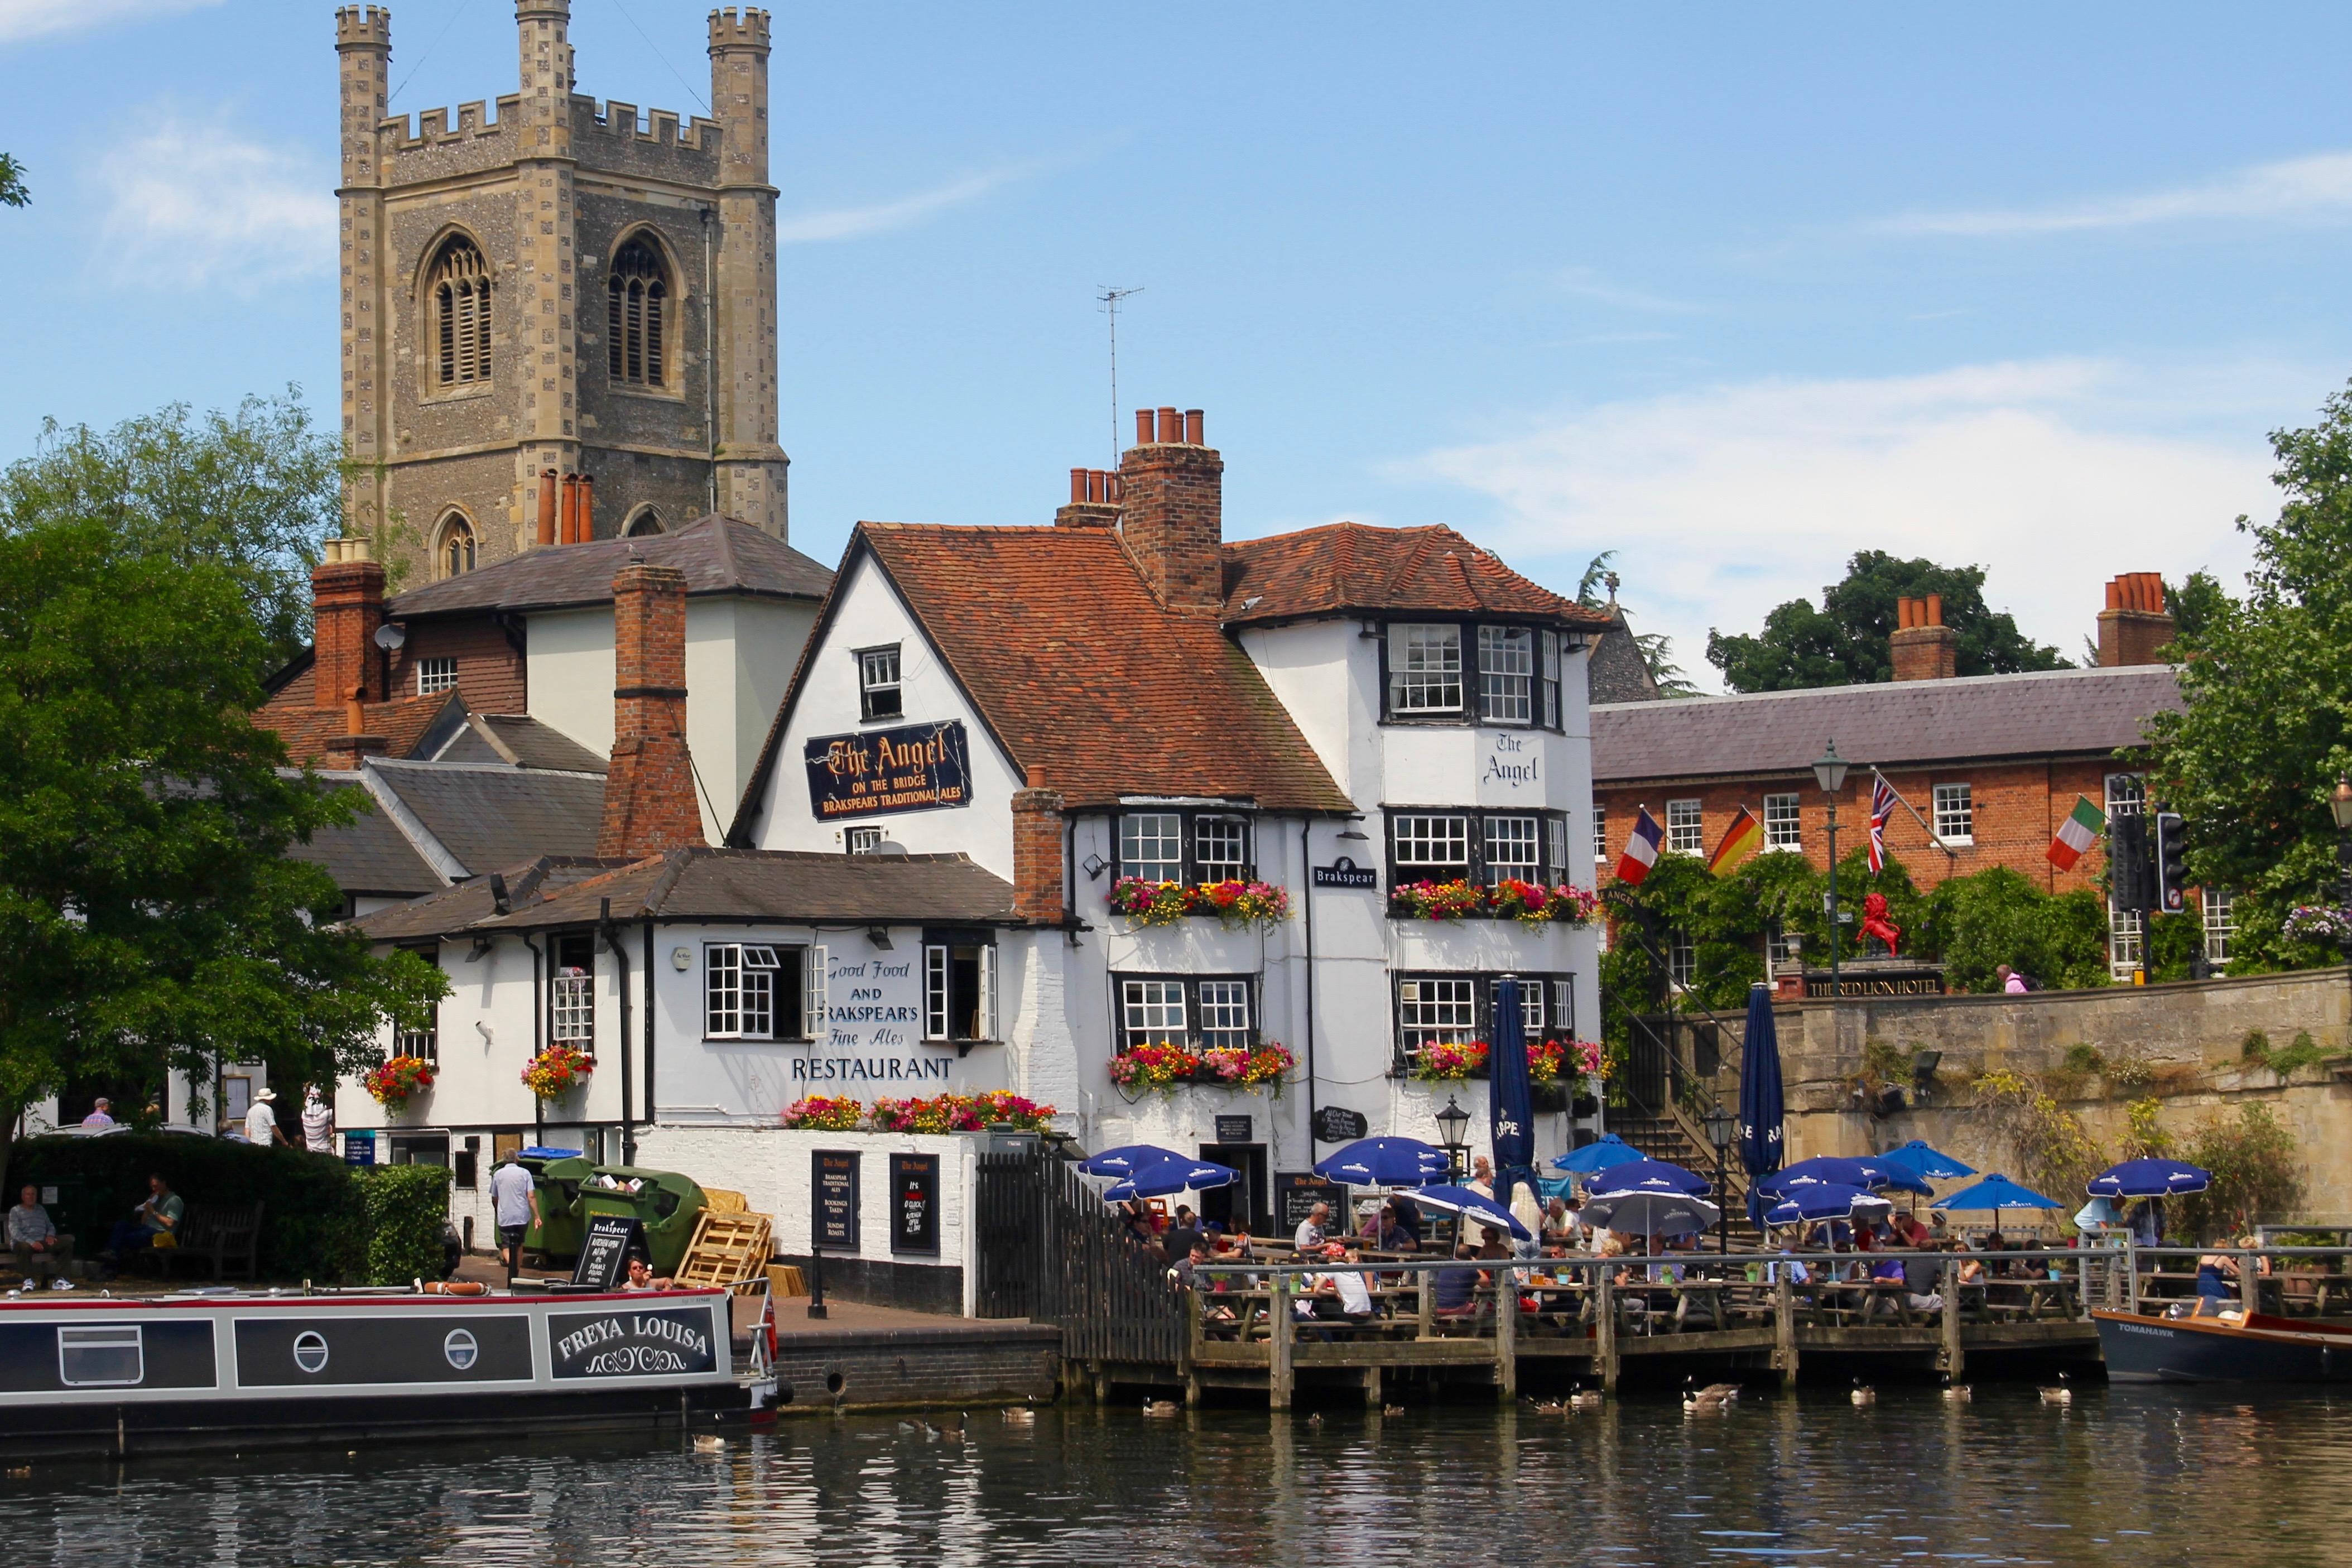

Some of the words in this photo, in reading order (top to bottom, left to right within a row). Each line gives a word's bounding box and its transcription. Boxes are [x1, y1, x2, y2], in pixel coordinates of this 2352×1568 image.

[1496, 733, 1522, 752] The
[826, 740, 870, 776] The
[878, 730, 947, 777] Angel
[1483, 756, 1538, 787] Angel
[852, 782, 866, 795] ON
[871, 779, 888, 791] THE
[893, 775, 926, 790] BRIDGE
[823, 796, 878, 814] BRAKSPEAR'S
[880, 790, 937, 807] TRADITIONAL
[940, 787, 961, 800] ALES
[1317, 870, 1374, 885] Brakspear
[1608, 891, 1634, 908] ANGEL
[828, 957, 867, 980] Good
[872, 960, 911, 980] Food
[850, 988, 882, 1001] AND
[1810, 983, 1833, 997] THE
[1839, 982, 1862, 995] RED
[1863, 981, 1895, 995] LION
[1897, 979, 1940, 994] HOTEL
[829, 1028, 858, 1046] Fine
[870, 1028, 904, 1045] Ales
[791, 1058, 953, 1081] RESTAURANT
[1295, 1177, 1307, 1186] The
[1309, 1177, 1327, 1187] Angel
[594, 1224, 628, 1234] Brakspear
[557, 1317, 626, 1362] FREYA
[633, 1315, 709, 1357] LOUISA
[2118, 1323, 2175, 1339] TOMAHAWK
